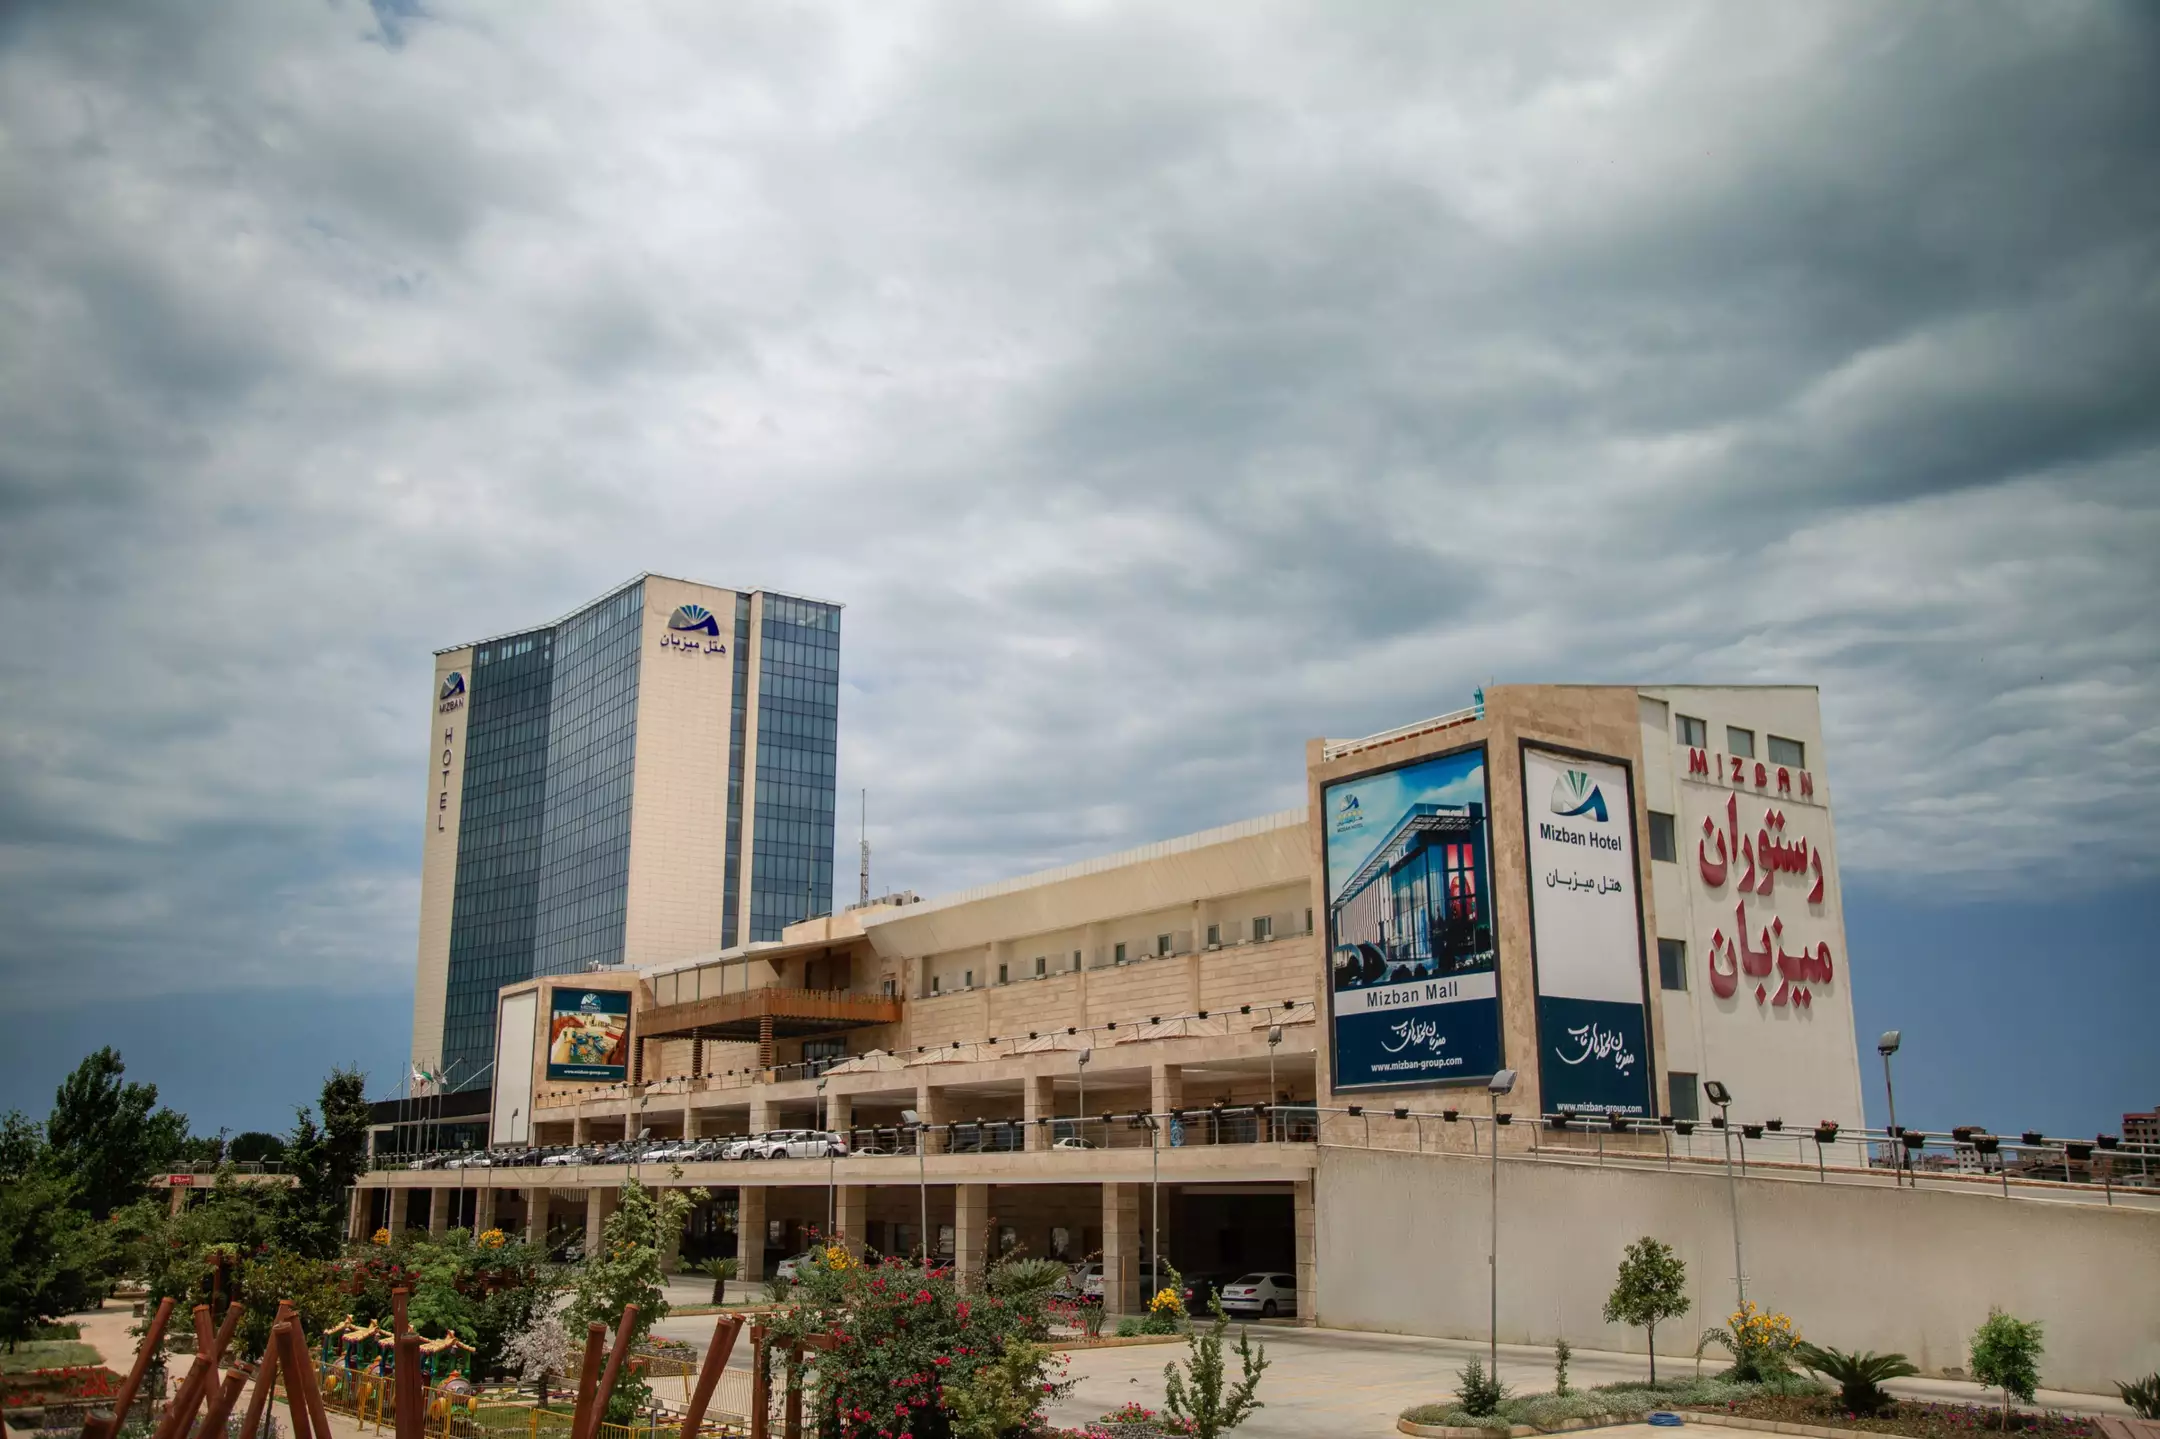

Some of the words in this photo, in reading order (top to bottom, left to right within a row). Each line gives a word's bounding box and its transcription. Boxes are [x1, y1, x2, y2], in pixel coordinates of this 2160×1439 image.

[660, 633, 699, 652] میزبان
[703, 640, 727, 655] هتل
[439, 697, 464, 713] MIZBAN
[438, 727, 453, 832] HOTEL
[1688, 748, 1815, 797] MIZBAN
[1540, 823, 1586, 846] Mizban
[1589, 832, 1622, 851] Hotel
[1699, 791, 1824, 905] رستوران
[1546, 868, 1595, 893] میزبان
[1597, 876, 1622, 895] هتل
[1709, 899, 1834, 1008] میزبان
[1367, 989, 1419, 1007] Mizban
[1426, 981, 1458, 1000] Mall
[1371, 1057, 1463, 1072] www.mizban-group.com
[1557, 1102, 1643, 1115] www.mizban-group.com
